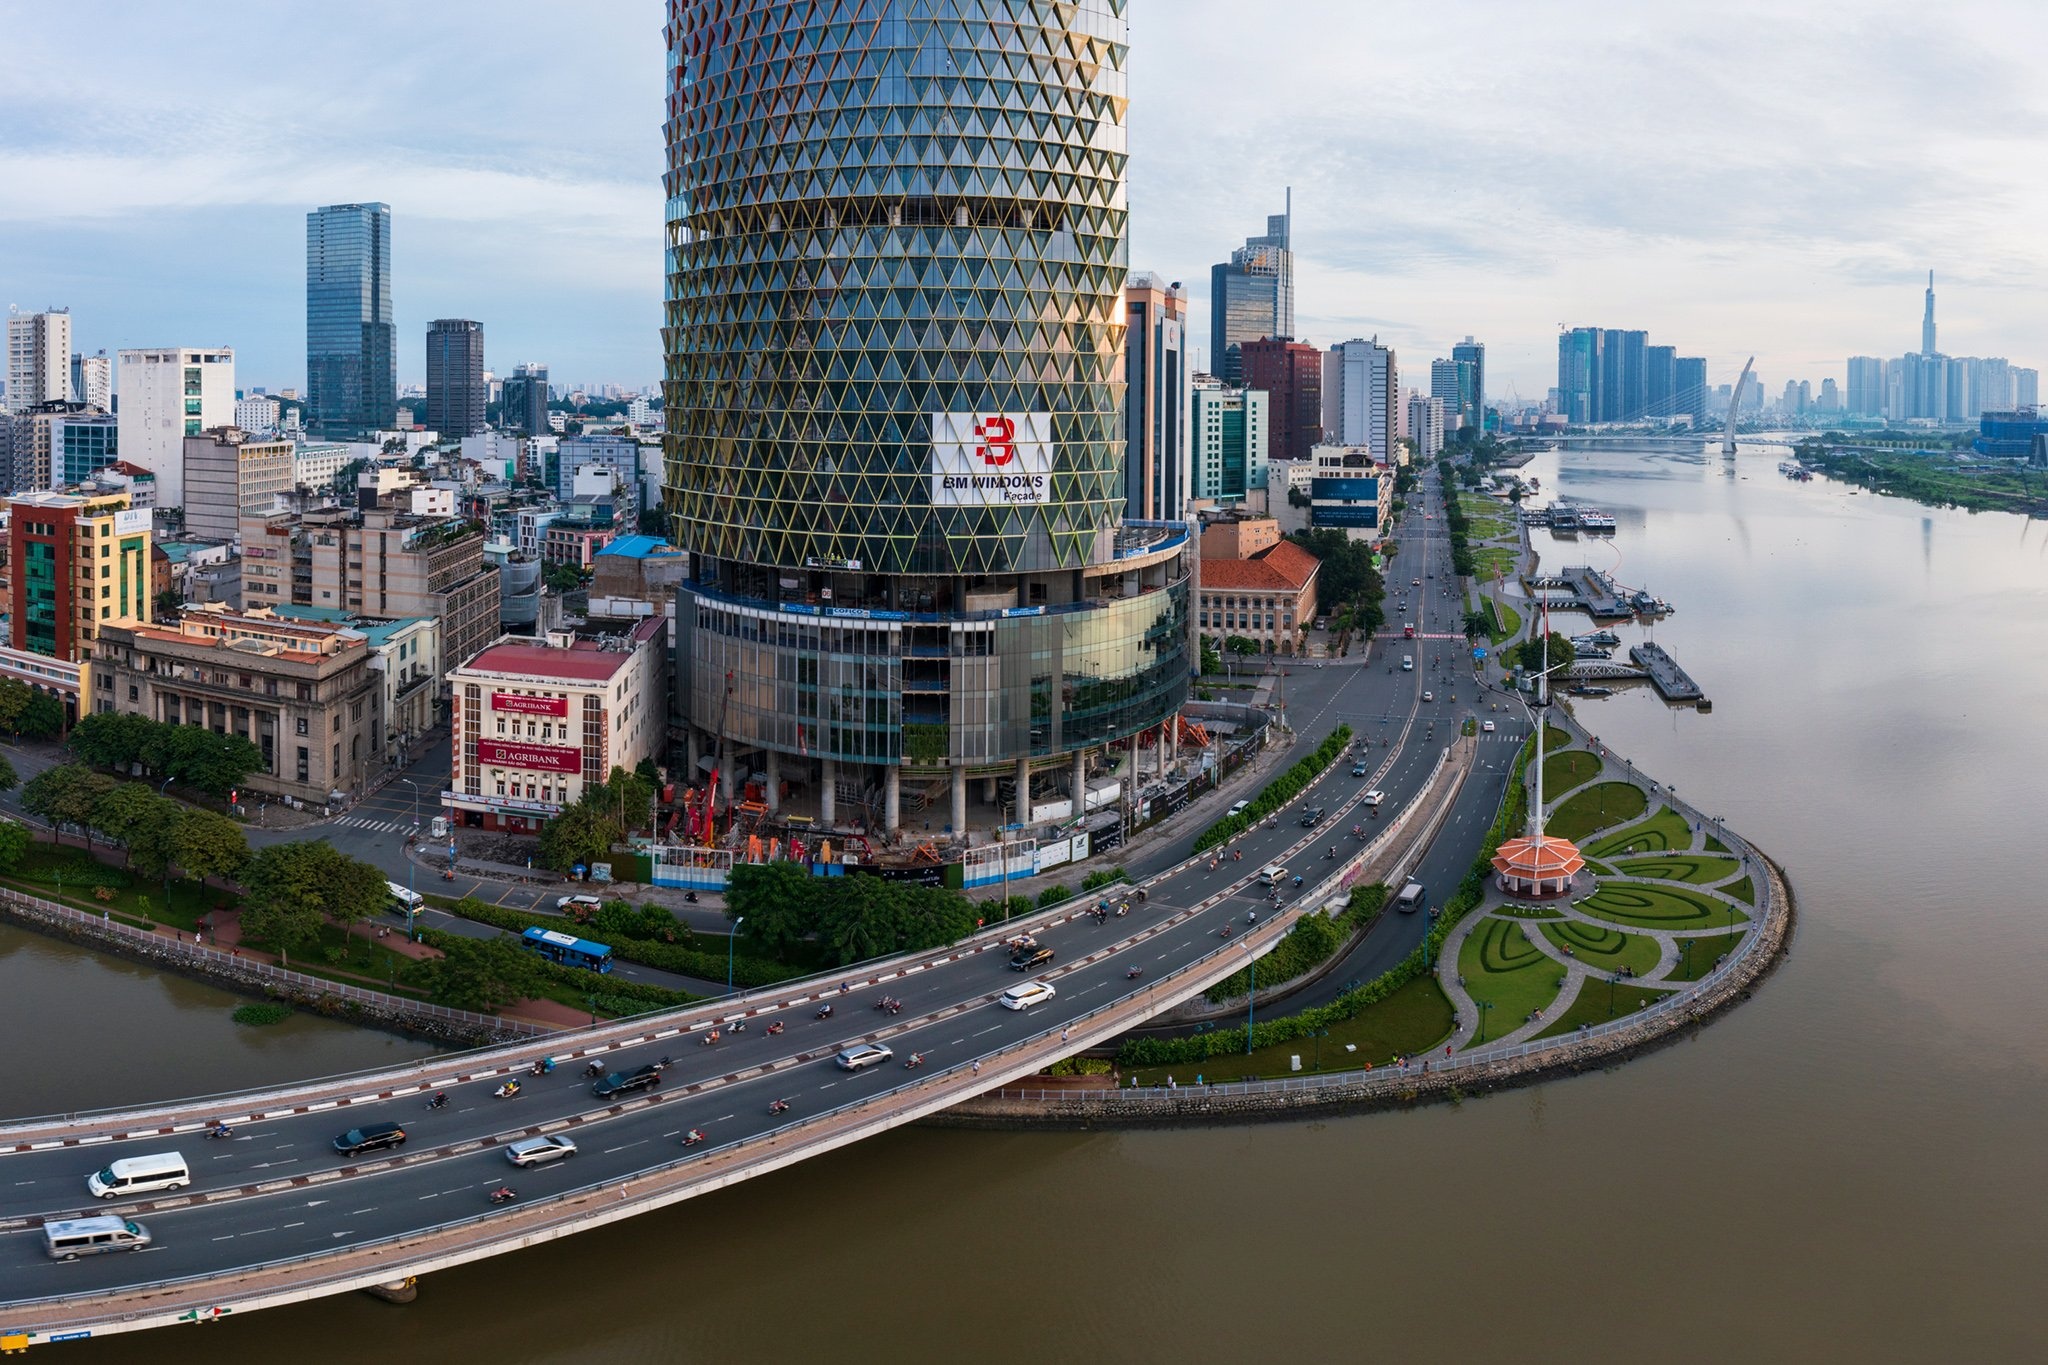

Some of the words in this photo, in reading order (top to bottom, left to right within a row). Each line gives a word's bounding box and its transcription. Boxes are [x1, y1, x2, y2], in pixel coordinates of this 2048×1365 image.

[943, 476, 968, 489] BM
[972, 475, 1043, 489] WINDOWS
[1004, 491, 1042, 503] Façade
[513, 702, 551, 711] AGRIBANK
[508, 753, 560, 765] AGRIBANK
